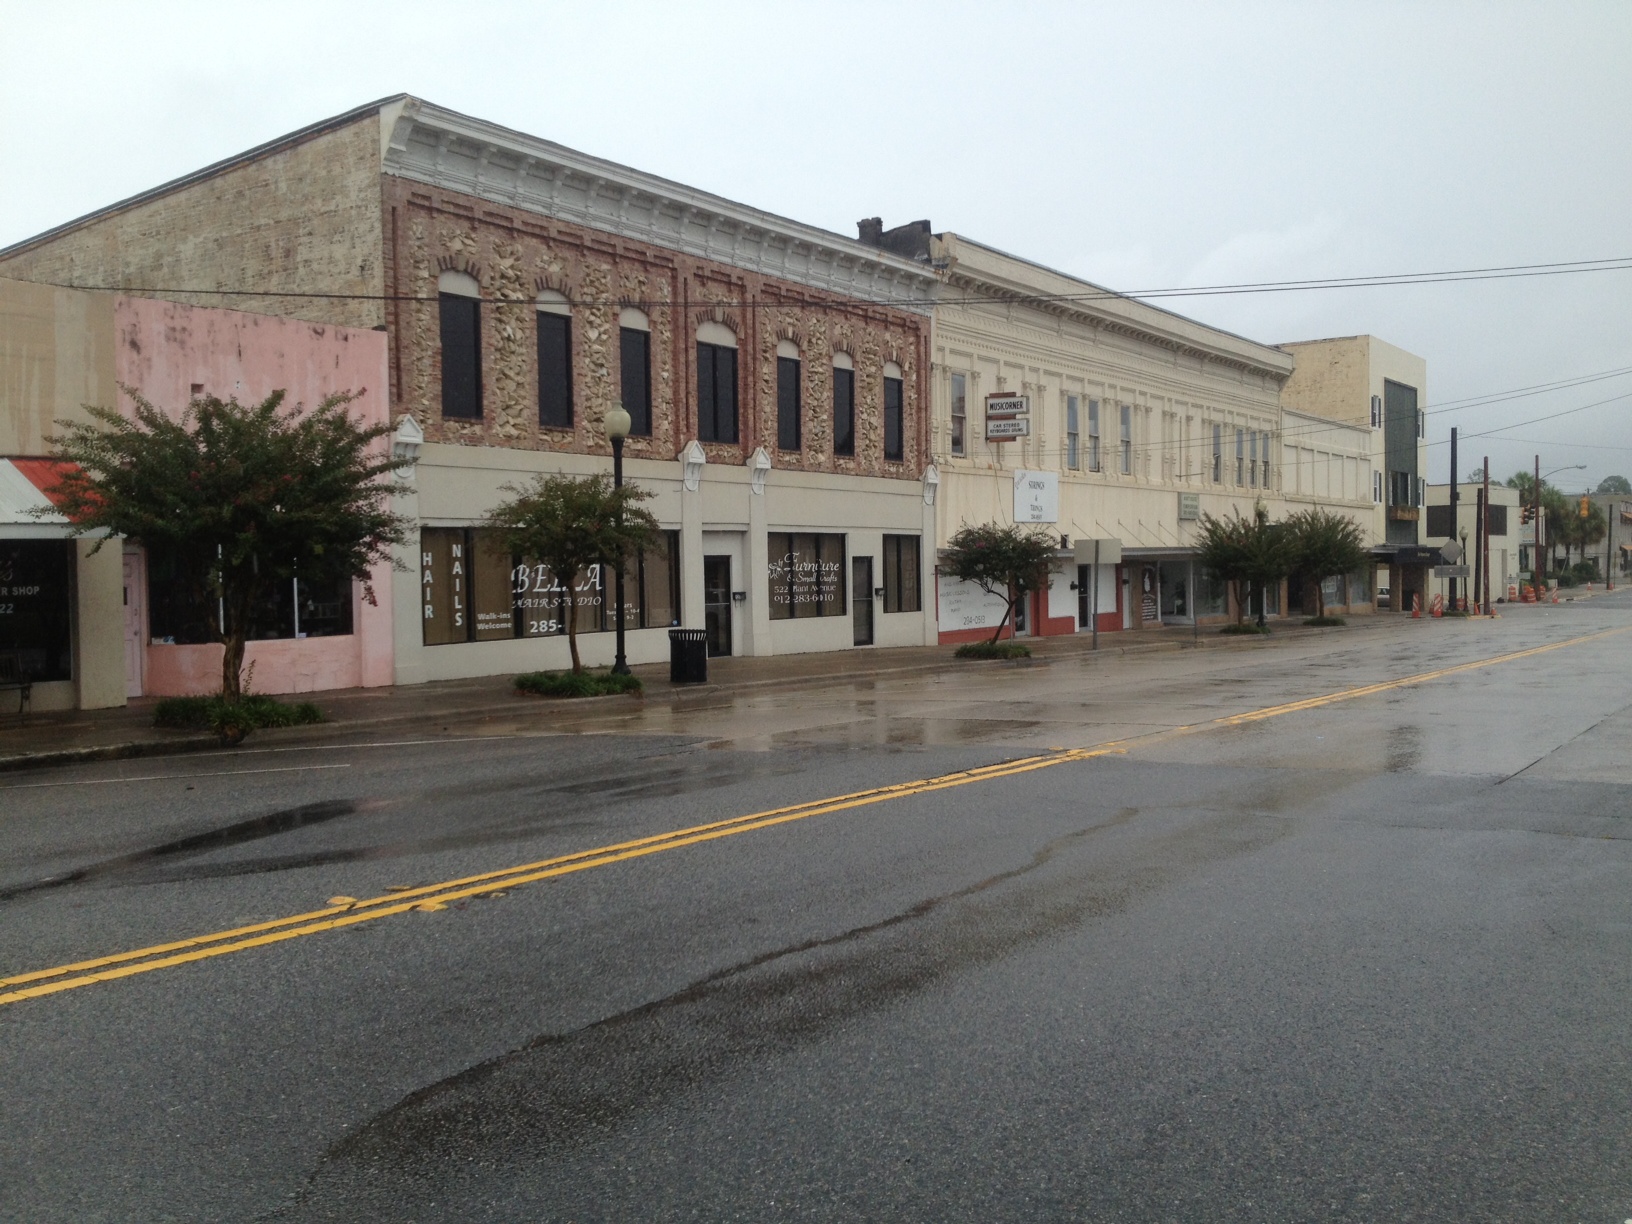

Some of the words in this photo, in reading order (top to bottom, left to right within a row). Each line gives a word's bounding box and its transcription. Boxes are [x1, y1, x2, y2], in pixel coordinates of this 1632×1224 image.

[990, 400, 1024, 411] MUSICORNER
[12, 585, 40, 596] SHOP
[423, 552, 434, 619] HAIR
[452, 544, 463, 626] NAILS
[774, 585, 789, 593] 522
[477, 612, 511, 620] Walk-ins
[476, 622, 513, 630] Welcome
